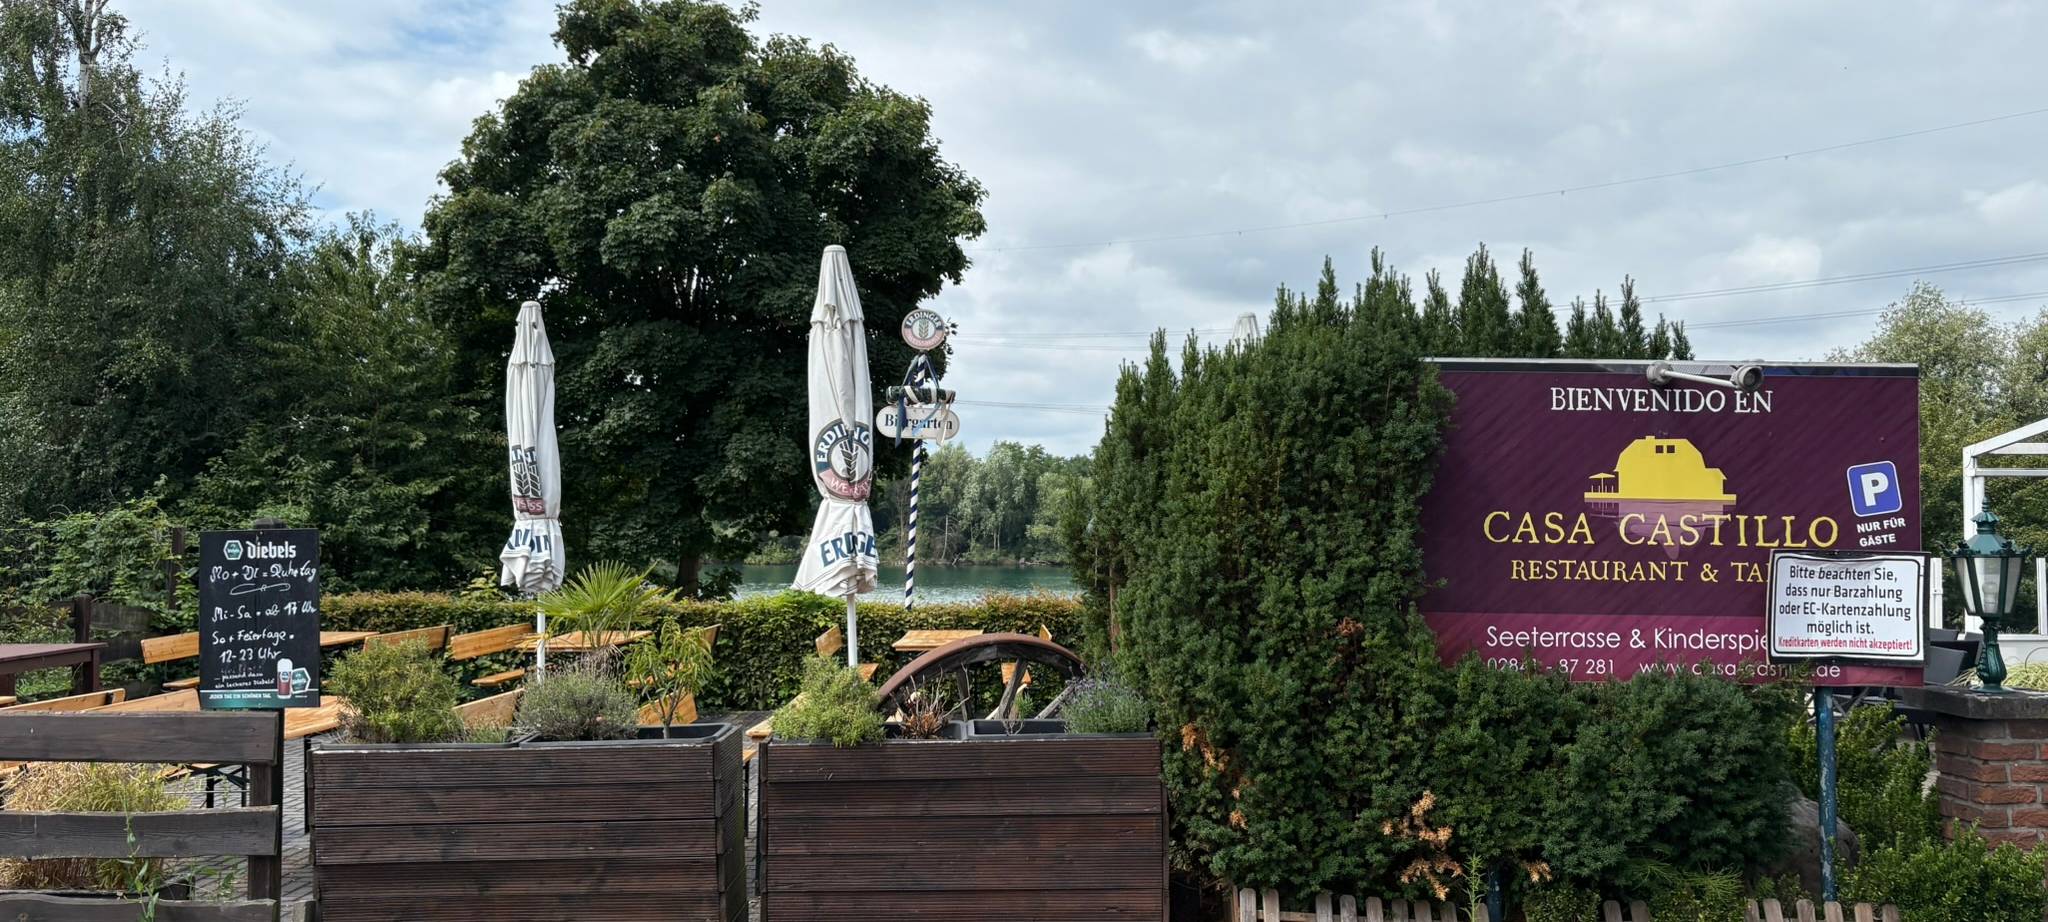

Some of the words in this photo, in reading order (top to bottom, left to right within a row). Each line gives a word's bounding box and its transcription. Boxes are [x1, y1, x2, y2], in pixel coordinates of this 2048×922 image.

[1550, 386, 1726, 413] BIENVENIDO
[1734, 389, 1773, 414] EN
[884, 413, 953, 431] Birgrtn
[1860, 471, 1890, 507] P
[1483, 510, 1597, 544] CASA
[1618, 512, 1839, 548] CASTILLO
[1856, 520, 1881, 533] NUR
[1882, 517, 1906, 530] FÜR
[245, 540, 297, 559] Diebels
[1859, 533, 1897, 548] GÄSTE
[209, 565, 230, 583] Mo
[269, 560, 317, 583] Ruhetag
[1510, 560, 1689, 583] RESTAURANT
[1700, 562, 1719, 583] &
[1731, 561, 1769, 583] TA
[1790, 564, 1815, 580] Bitte
[1818, 567, 1871, 581] beachten
[1874, 567, 1898, 583] Sie,
[1785, 583, 1808, 597] dass
[1810, 587, 1831, 598] nur
[1833, 585, 1903, 603] Barzahlung
[1779, 601, 1802, 615] oder
[1803, 602, 1911, 622] EC-Kartenzahlung
[212, 630, 226, 645] So
[1806, 619, 1853, 637] möglich
[1855, 620, 1875, 635] ist.
[1486, 626, 1621, 649] Seeterrasse
[1629, 629, 1647, 649] &
[1653, 626, 1768, 656] Kinderspie
[1778, 636, 1819, 648] Kreditkarten
[1820, 637, 1848, 648] werden
[1849, 637, 1868, 649] nicht
[1869, 638, 1913, 652] akzeptiert!
[257, 647, 282, 660] Uhr
[1558, 658, 1579, 674] 87
[1585, 658, 1615, 675] 281
